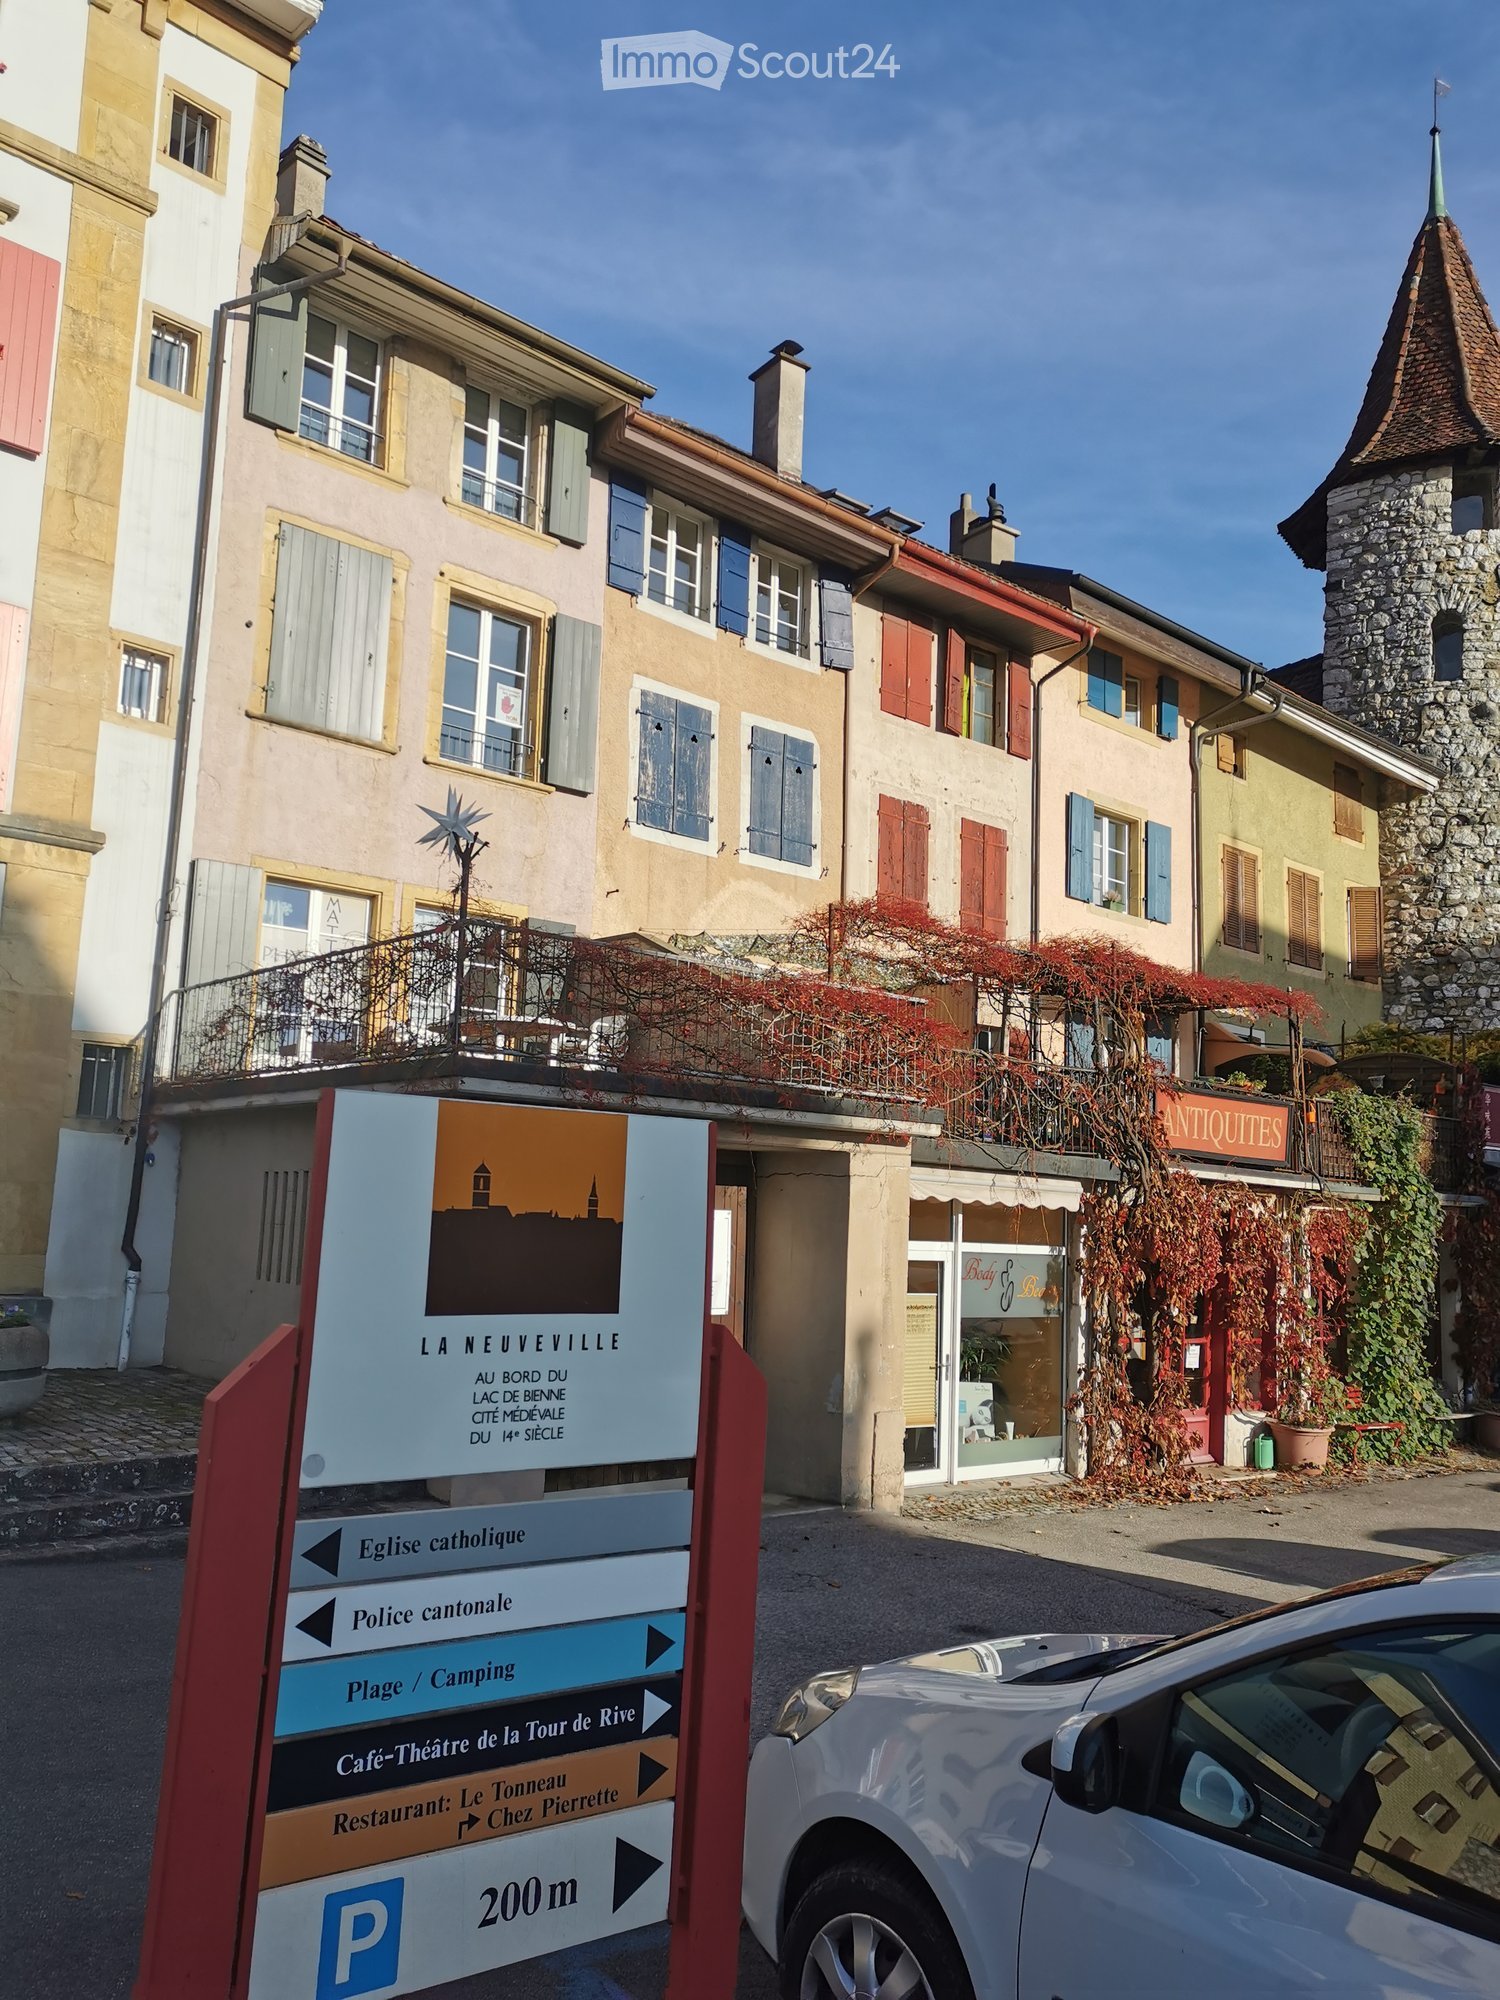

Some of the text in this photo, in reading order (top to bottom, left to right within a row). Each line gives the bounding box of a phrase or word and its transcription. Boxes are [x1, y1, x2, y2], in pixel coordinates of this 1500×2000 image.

[962, 1257, 998, 1291] Body
[421, 1333, 619, 1355] LA NEUVEVILLE
[475, 1369, 568, 1385] AU BORD DU
[472, 1388, 566, 1404] LAC DE BIENNE
[472, 1404, 565, 1424] CITÉ MÉDIÉVALE
[470, 1431, 491, 1445] DU
[524, 1424, 564, 1442] SIÈCLE
[358, 1526, 526, 1562] Eglise catholique
[352, 1592, 513, 1631] Police cantonale
[345, 1660, 516, 1704] Plage / Camping
[336, 1705, 636, 1776] Café-Théâtre de la Tour de Rive
[332, 1773, 567, 1835] Restaurant: Le Tonneau
[487, 1787, 619, 1830] Chez Pierrette
[335, 1876, 578, 1985] P 200 m
